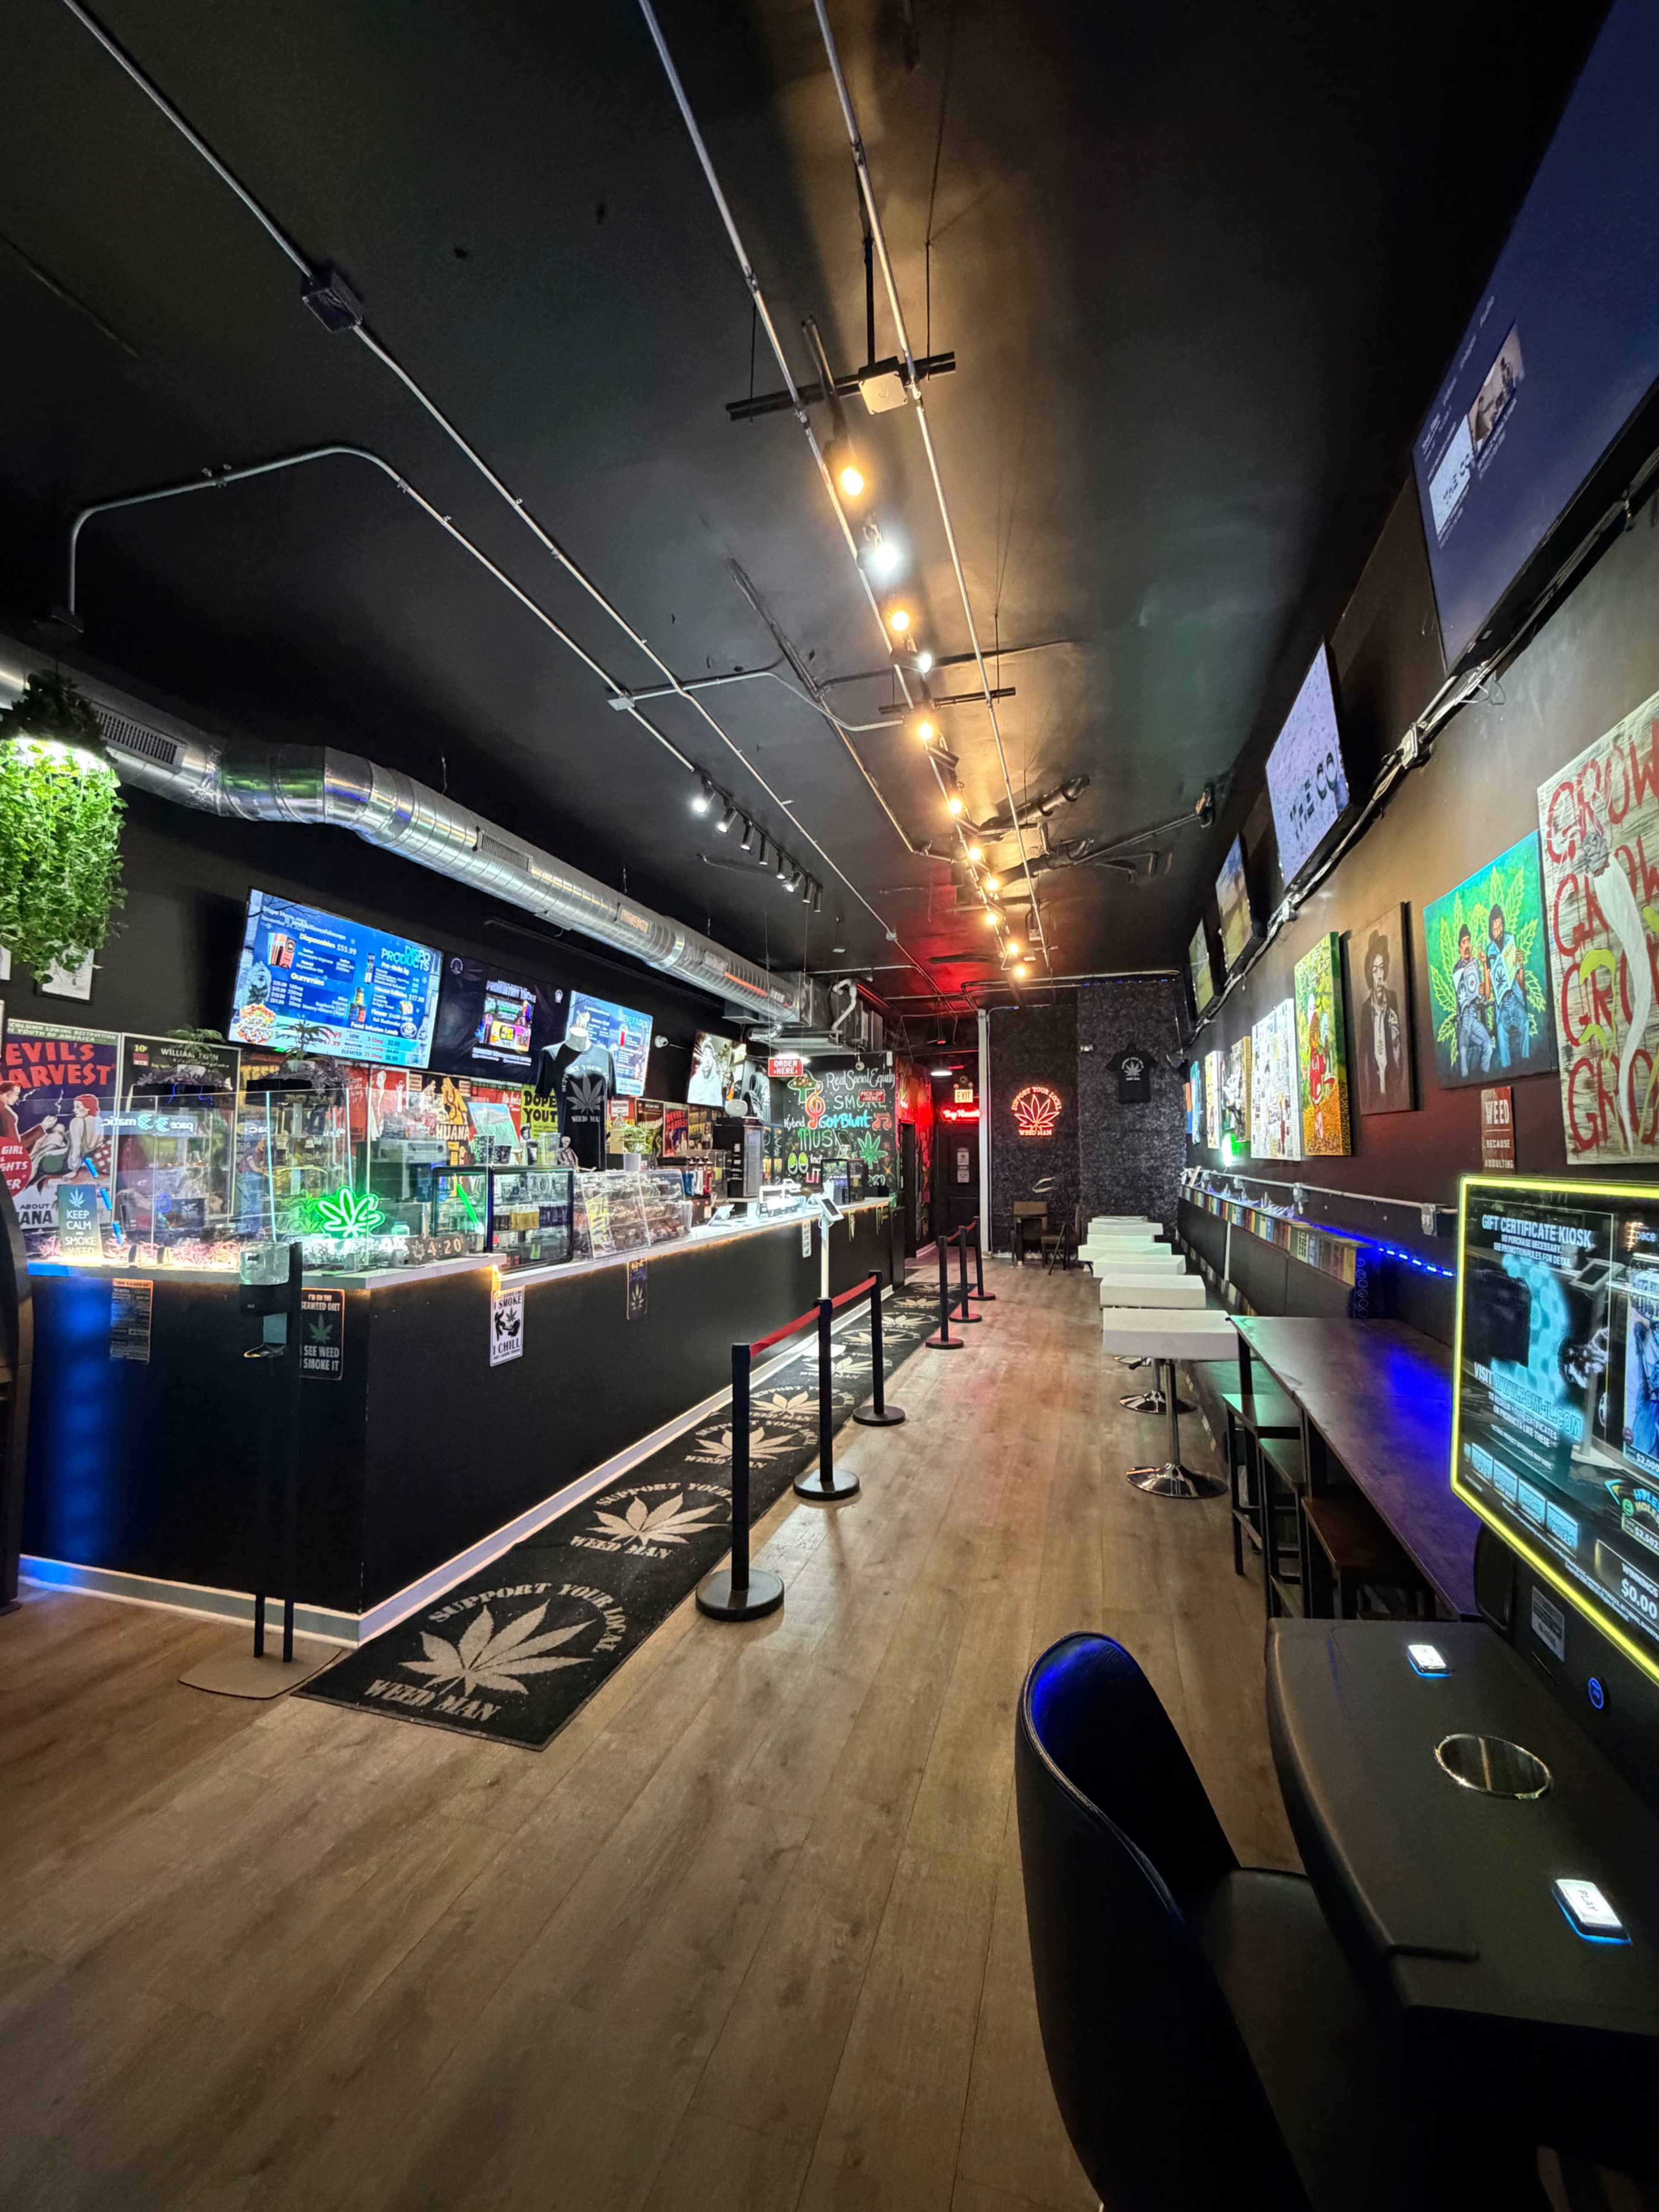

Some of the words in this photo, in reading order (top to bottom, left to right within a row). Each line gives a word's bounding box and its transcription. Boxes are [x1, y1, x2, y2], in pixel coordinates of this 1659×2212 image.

[380, 947, 430, 972] PRODUCTS
[404, 944, 431, 963] DISPO
[290, 972, 325, 987] Gummies
[825, 1070, 846, 1091] Real
[1032, 1086, 1049, 1095] YOUR
[1485, 1099, 1510, 1124] WEED
[1486, 1139, 1510, 1149] BECAUSE
[66, 1210, 90, 1219] KEEP
[66, 1221, 92, 1230] CALM
[1482, 1214, 1500, 1231] GIFT
[1500, 1217, 1558, 1242] CERTIFICATE
[1558, 1225, 1592, 1248] KIOSK
[65, 1237, 97, 1246] SMOKE
[1501, 1234, 1508, 1242] NO
[1508, 1235, 1532, 1248] PURCHASE
[1635, 1231, 1656, 1243] pace
[1494, 1242, 1502, 1251] SEE
[1502, 1244, 1530, 1258] PROMOTION
[1542, 1253, 1553, 1264] FOR
[327, 1302, 340, 1311] DIET
[494, 1301, 496, 1310] I
[498, 1295, 521, 1309] SMOKE
[304, 1345, 317, 1356] SEE
[319, 1346, 340, 1358] WEED
[493, 1345, 496, 1356] I
[498, 1338, 520, 1353] CHILL
[303, 1359, 330, 1371] SMOKE
[331, 1361, 340, 1371] IT
[1474, 1361, 1493, 1385] VISIT
[596, 1482, 681, 1506] SUPPORT
[687, 1483, 732, 1497] YOUR
[570, 1535, 622, 1552] WEED
[625, 1544, 673, 1560] MAN
[1621, 1563, 1659, 1598] WINNINGS
[1621, 1578, 1658, 1619] $0.00
[428, 1582, 553, 1623] SUPPORT
[558, 1583, 614, 1611] YOUR
[592, 1606, 627, 1654] LOCAL
[364, 1679, 435, 1707] WEED
[435, 1695, 502, 1722] MAN
[1577, 1890, 1599, 1912] PLAY
